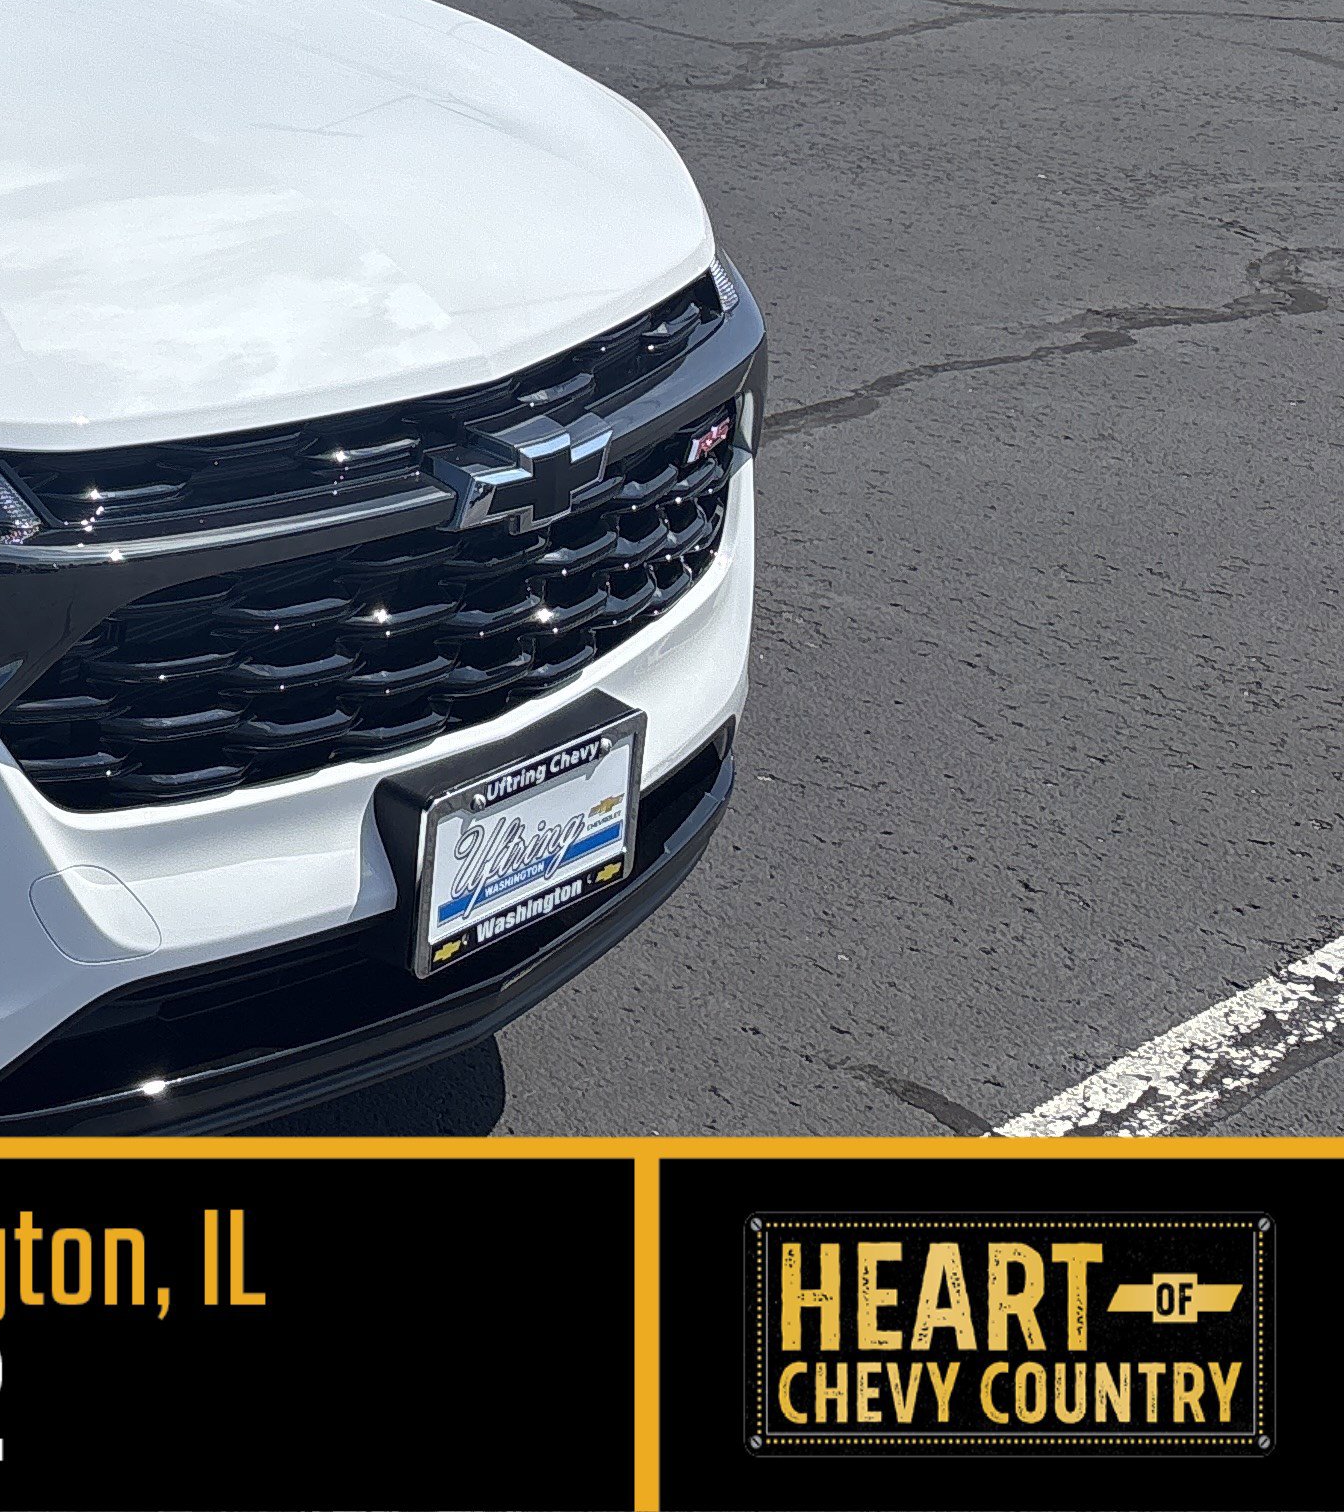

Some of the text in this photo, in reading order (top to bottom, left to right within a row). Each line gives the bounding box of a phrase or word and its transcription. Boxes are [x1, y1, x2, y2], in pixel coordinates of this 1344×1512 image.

[486, 741, 600, 801] Uftring Chevy
[451, 813, 585, 918] Uftring
[484, 862, 545, 898] WASHINGTON
[476, 879, 582, 943] Washington
